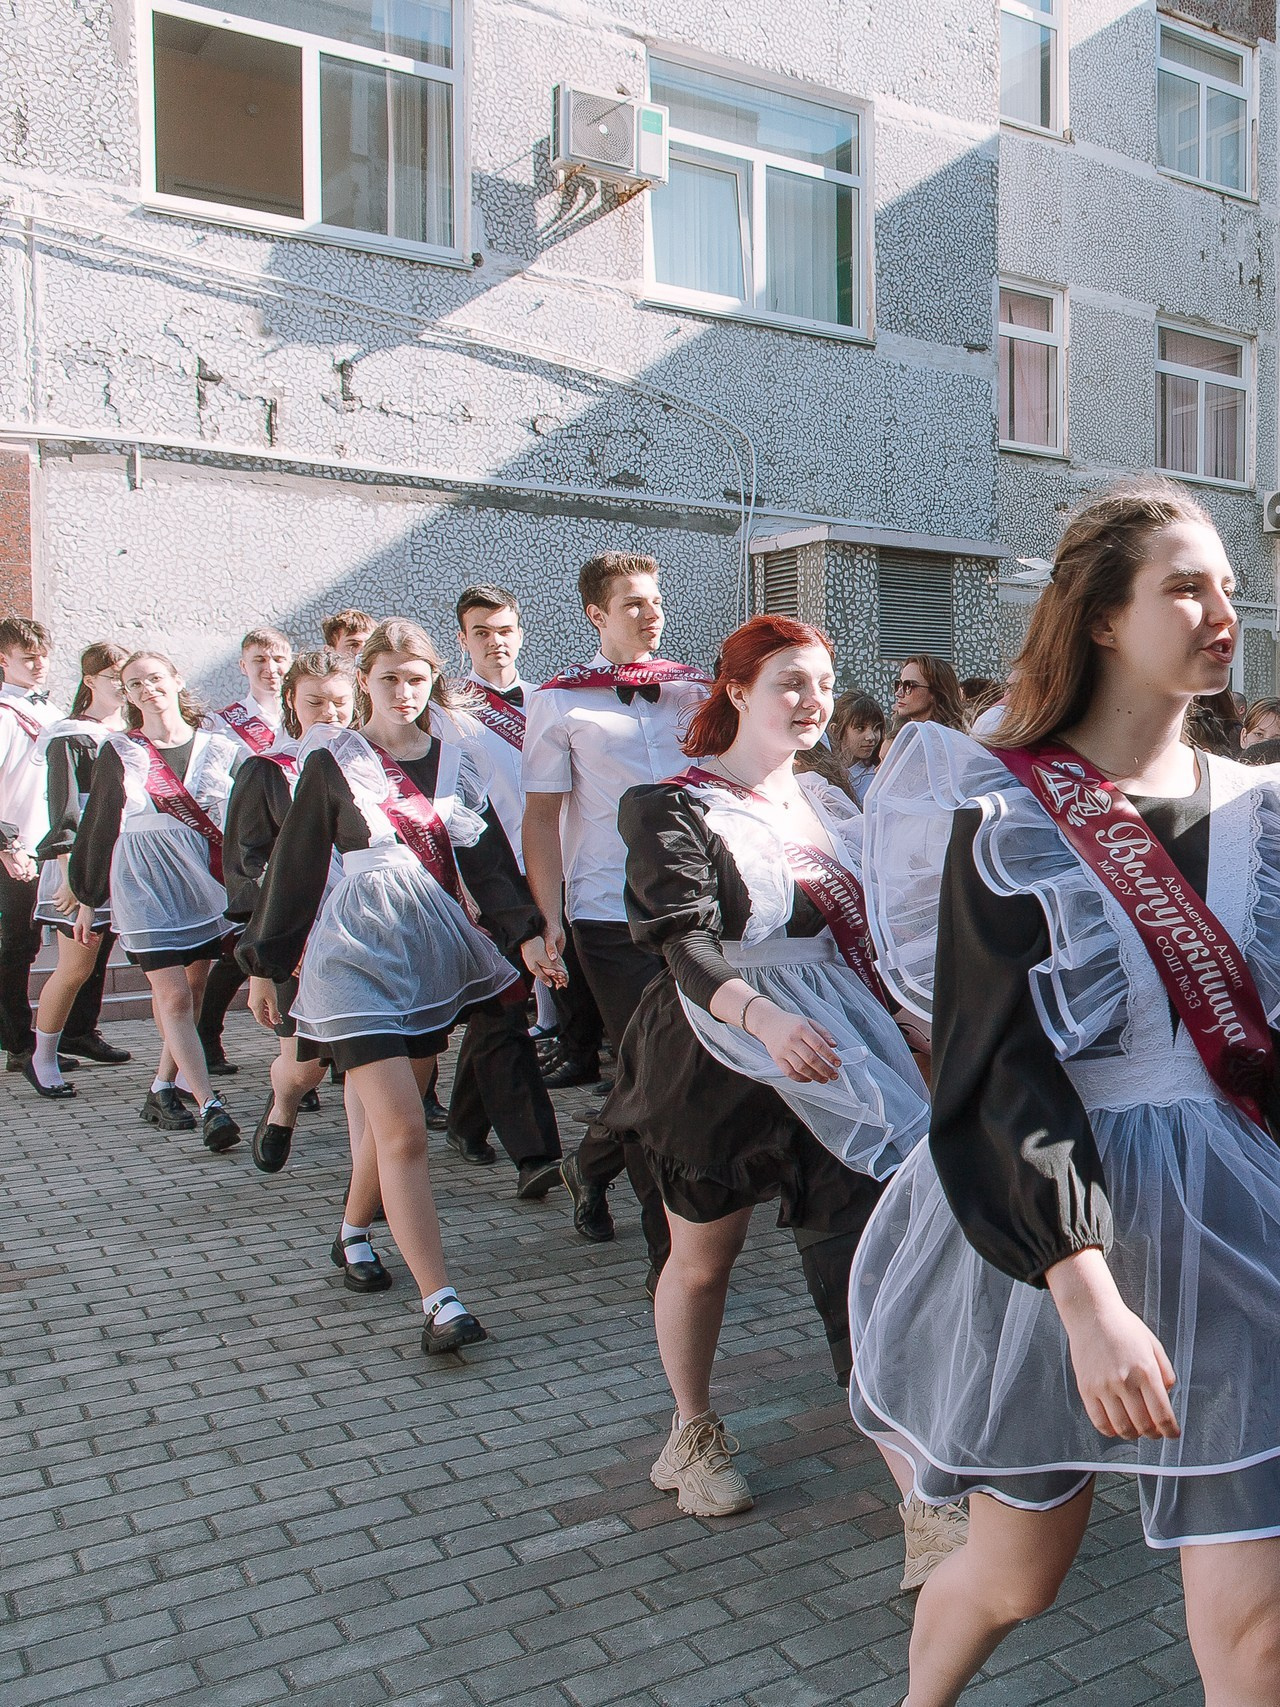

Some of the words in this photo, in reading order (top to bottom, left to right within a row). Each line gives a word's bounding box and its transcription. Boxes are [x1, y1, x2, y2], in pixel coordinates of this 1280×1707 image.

[804, 877, 820, 893] ОШ
[817, 891, 835, 911] №33
[825, 860, 860, 902] Анастасия
[1095, 821, 1247, 1047] Выпускница
[1097, 859, 1137, 897] МАОУ
[1155, 935, 1183, 975] СОШ
[1176, 973, 1202, 1010] №33
[1161, 876, 1217, 943] Адаменко
[1214, 944, 1244, 991] Алина
